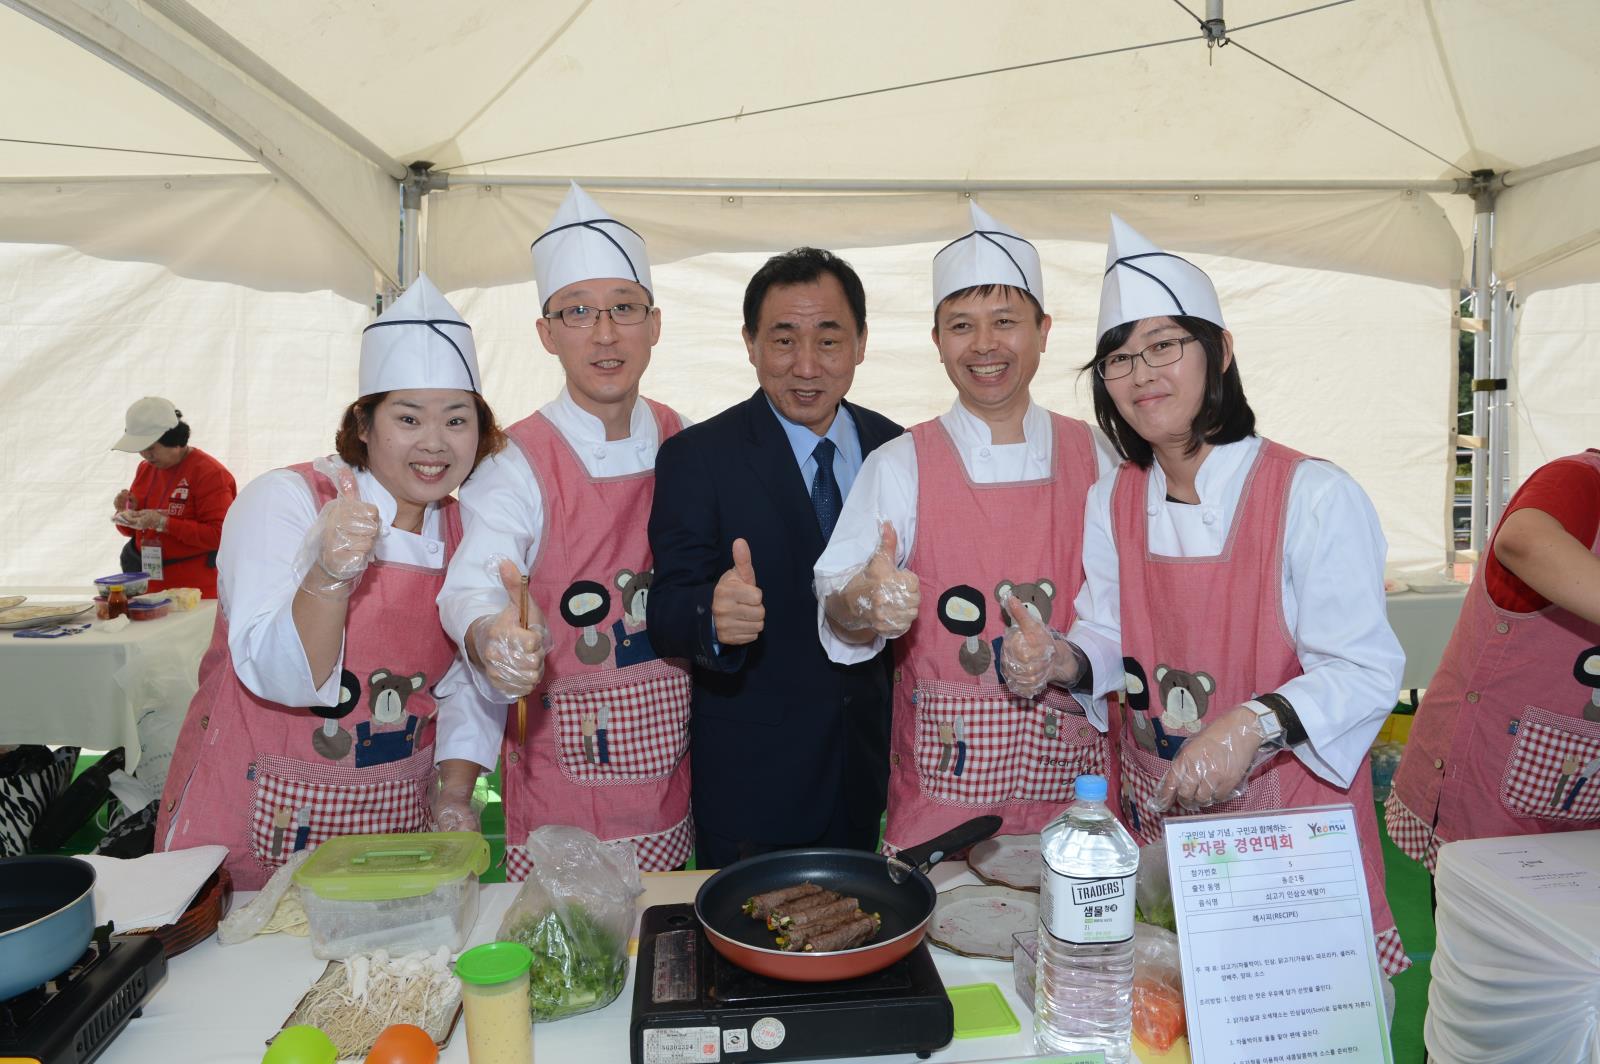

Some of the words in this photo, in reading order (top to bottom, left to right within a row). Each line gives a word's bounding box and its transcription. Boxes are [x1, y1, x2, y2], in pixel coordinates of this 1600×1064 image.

[1208, 830, 1215, 838] 날
[1236, 826, 1258, 836] 구민과
[1308, 822, 1346, 837] Yeonsu
[1182, 840, 1227, 858] 맛자랑
[1234, 834, 1294, 854] 경연대회
[1077, 881, 1120, 900] TRADERS
[1266, 891, 1285, 901] 쇠고기
[1084, 906, 1103, 917] 샘물
